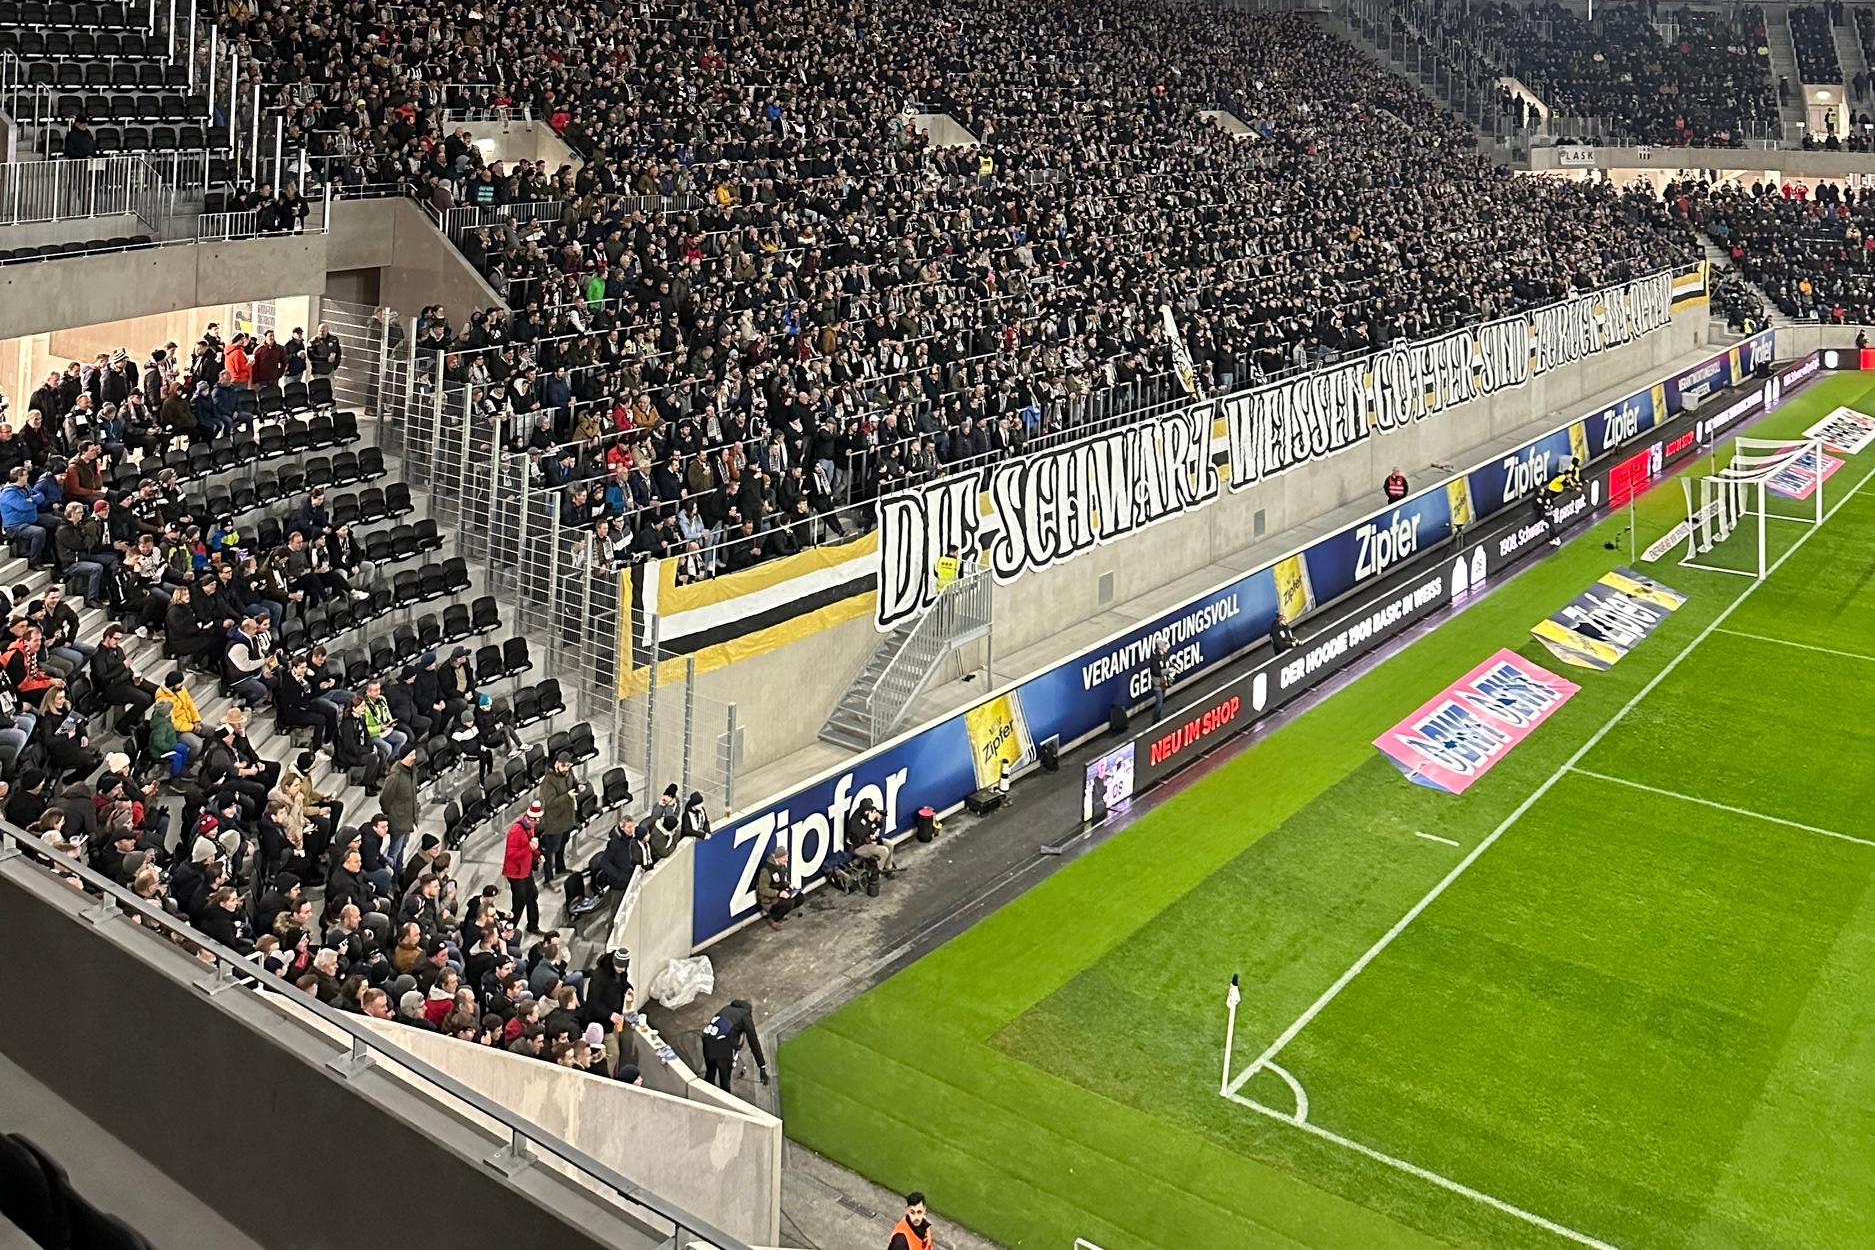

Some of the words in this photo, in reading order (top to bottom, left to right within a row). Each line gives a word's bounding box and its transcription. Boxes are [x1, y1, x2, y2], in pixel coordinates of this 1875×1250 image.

[1566, 151, 1594, 160] LASK
[1603, 401, 1640, 450] Zipfer
[880, 474, 979, 623] DIE
[992, 404, 1218, 579] SCHWARZ
[1225, 363, 1370, 492] WEISSEN
[1373, 339, 1475, 430] GÖTTER
[1480, 313, 1529, 392] SIND
[1503, 446, 1551, 503] Zipfer
[1355, 510, 1421, 582] Zipfer
[1083, 594, 1240, 691] VERANTWORTUNGSVOLL
[1281, 656, 1306, 689] DER
[1306, 631, 1349, 674] HOODIE
[1349, 617, 1373, 648] 1908
[1373, 600, 1403, 634] BASIC
[1402, 593, 1414, 615] IN
[1414, 576, 1443, 609] WEISS
[1561, 592, 1662, 647] Zipfer
[982, 719, 1014, 764] Zipfer
[1150, 729, 1182, 766] NEU
[1184, 718, 1200, 746] IM
[1202, 696, 1239, 735] SHOP
